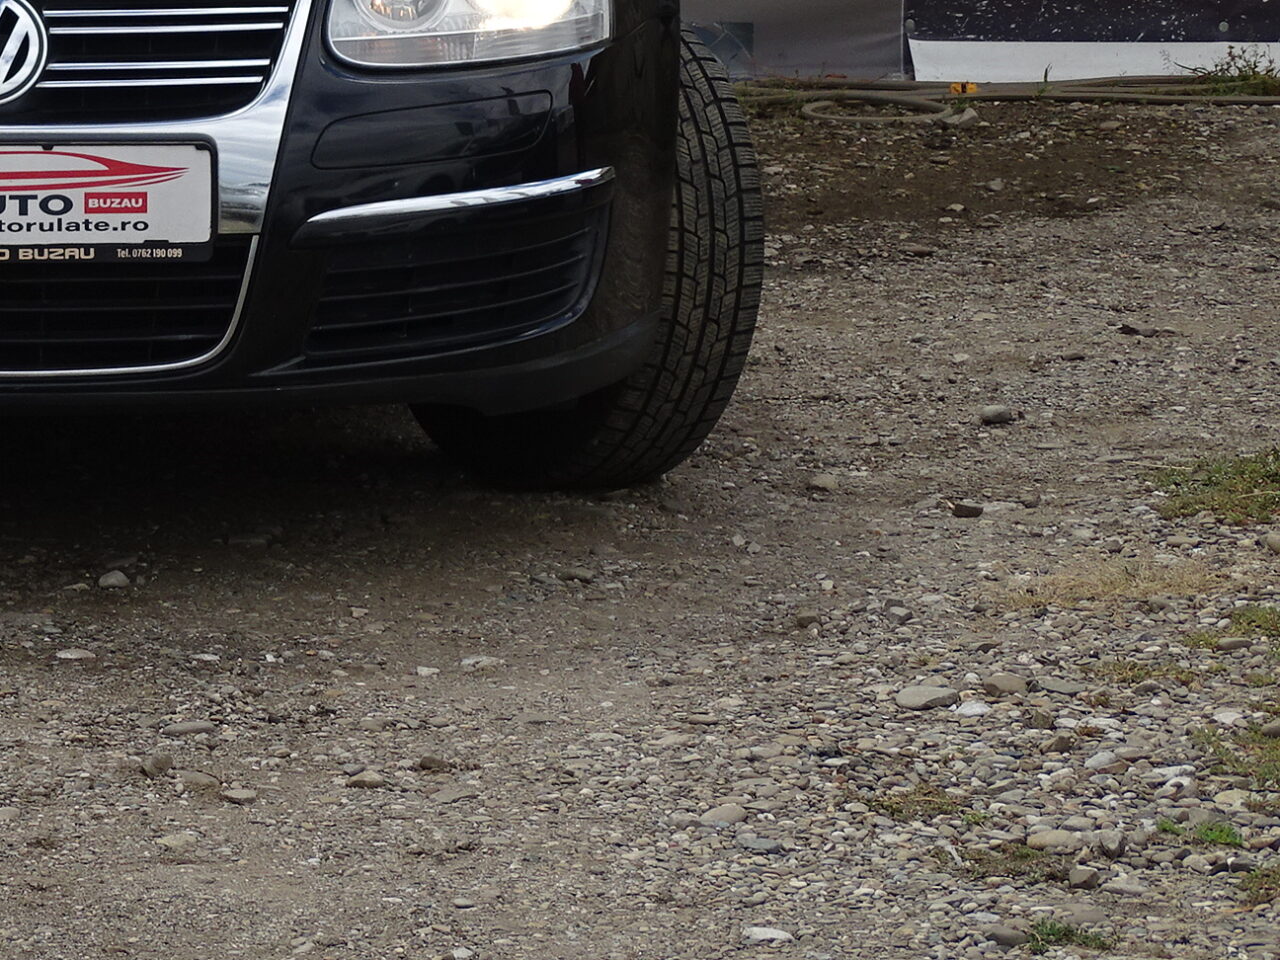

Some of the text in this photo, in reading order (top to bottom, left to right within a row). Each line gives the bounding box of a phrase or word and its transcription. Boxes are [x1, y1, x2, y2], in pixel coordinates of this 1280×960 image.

[88, 197, 143, 209] BUZAU
[18, 247, 95, 260] BUZAU
[116, 248, 182, 258] Tel. 0762 190 099
